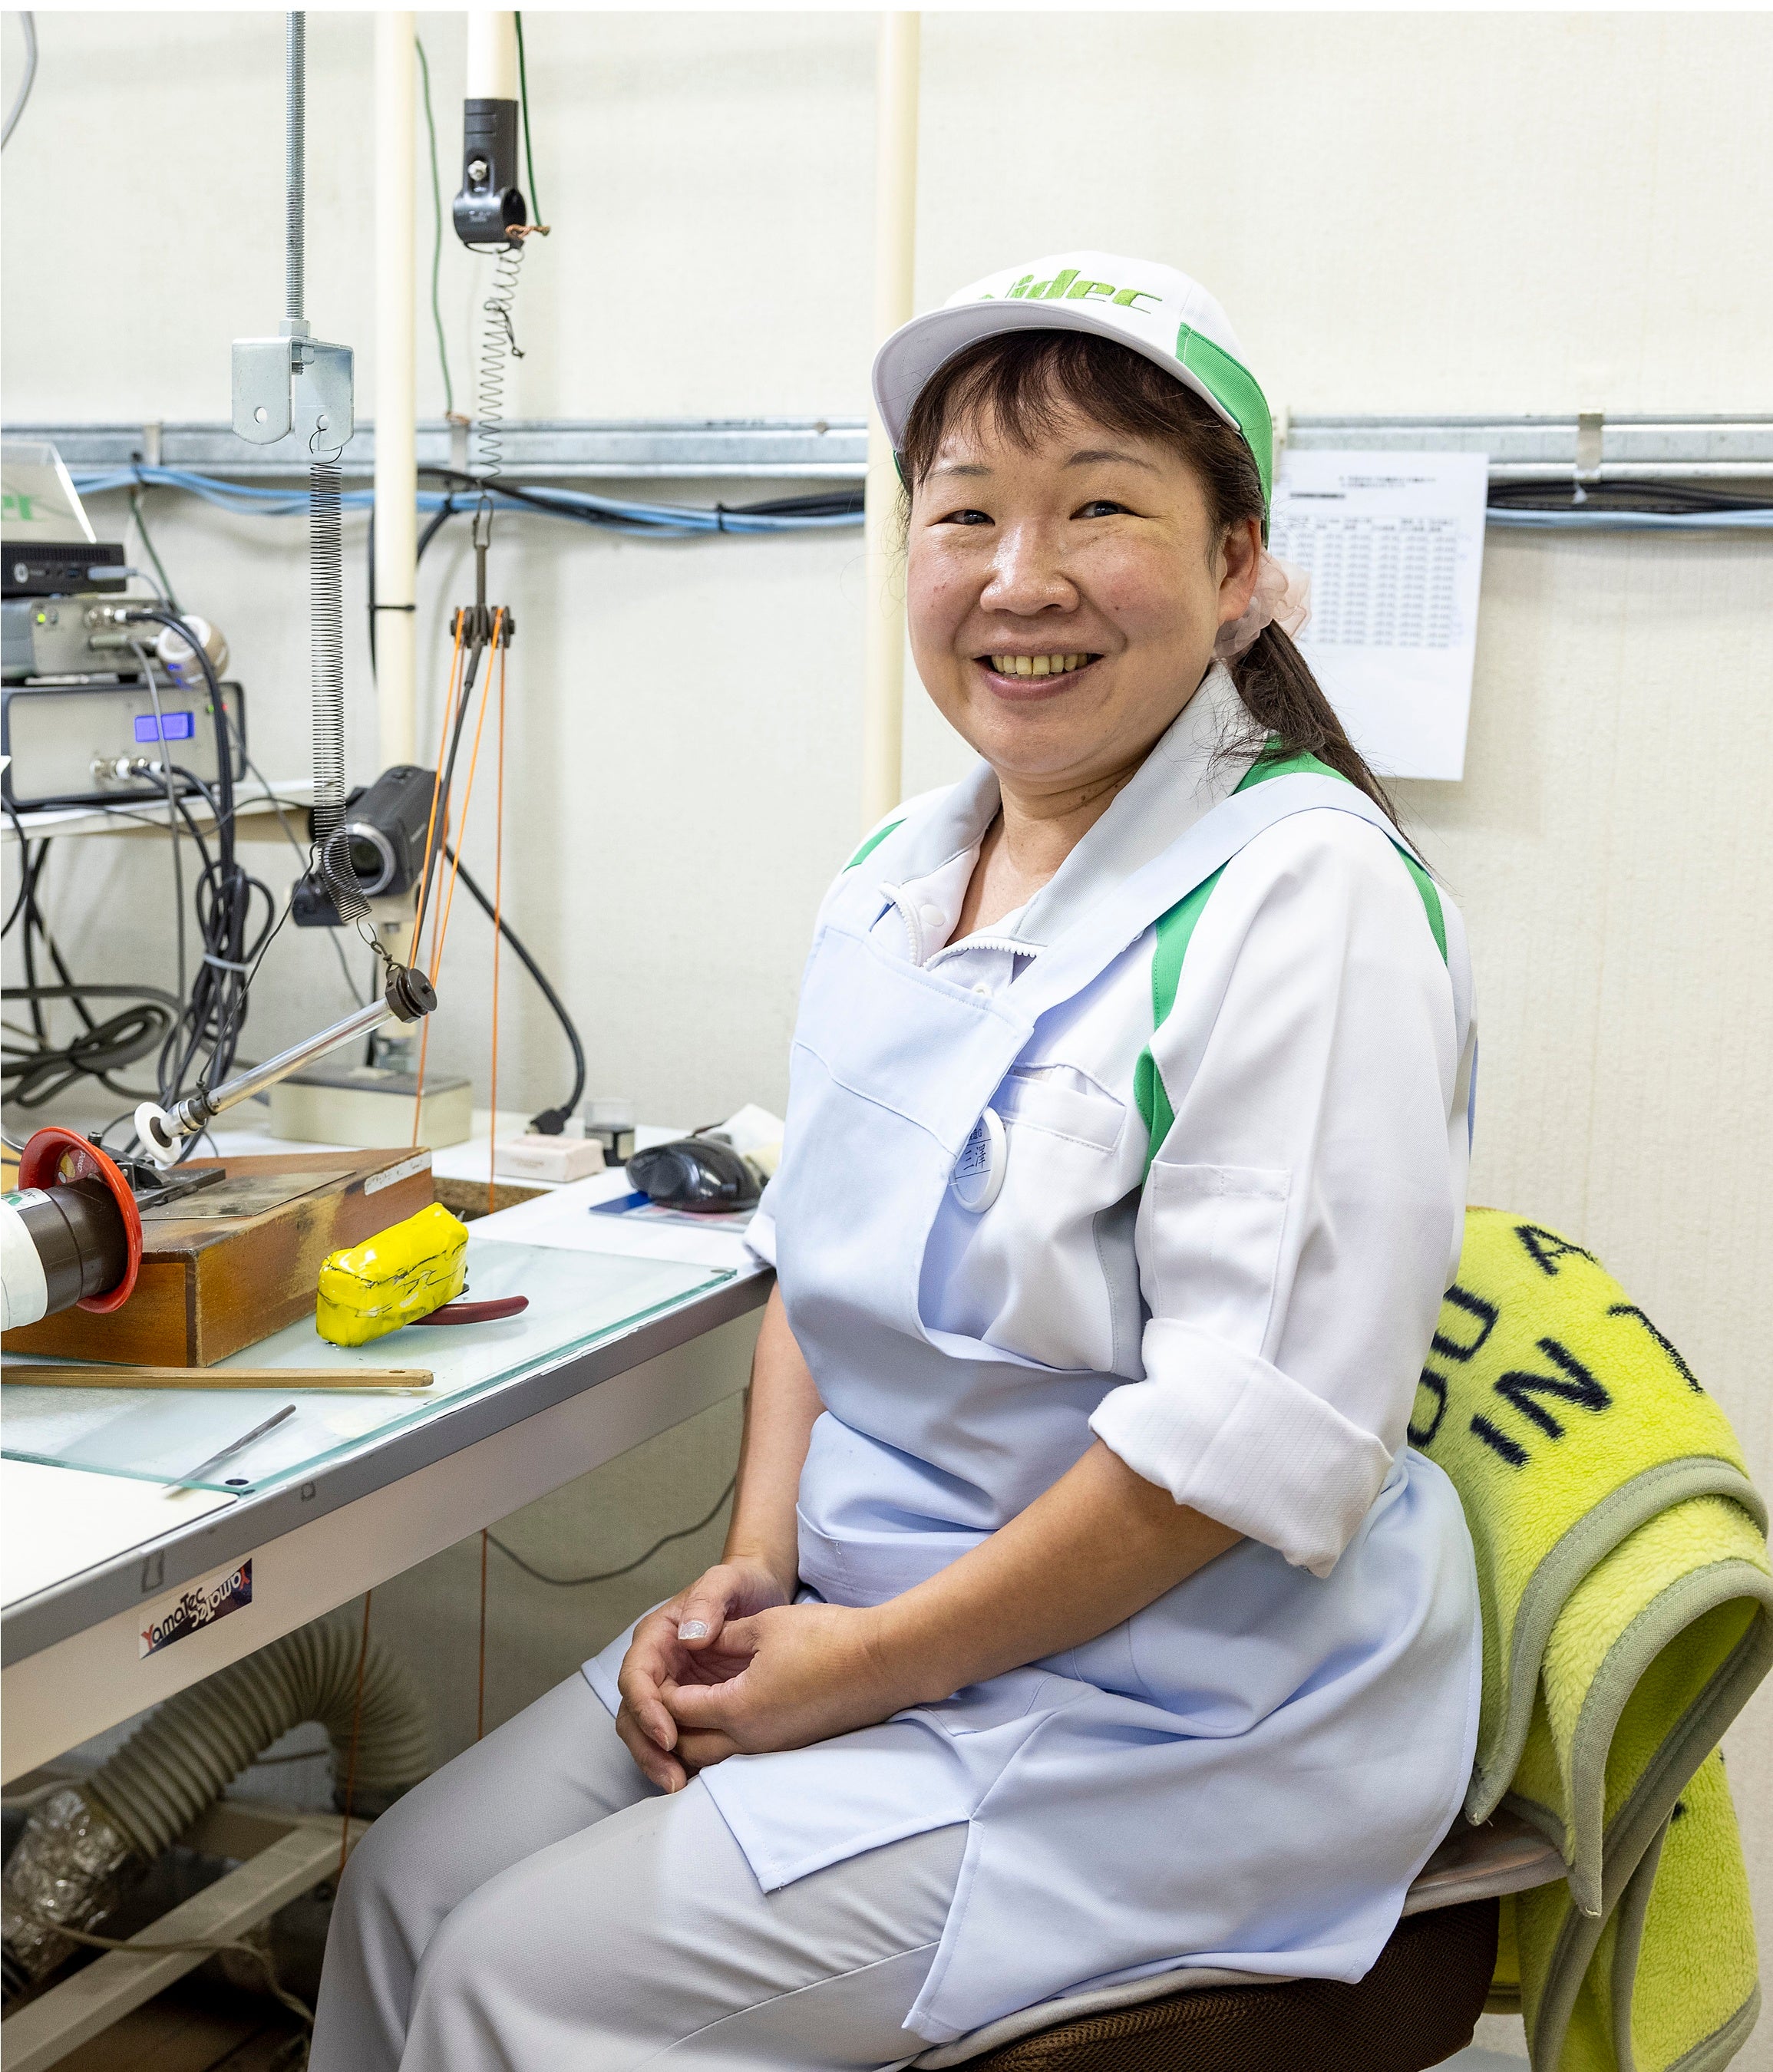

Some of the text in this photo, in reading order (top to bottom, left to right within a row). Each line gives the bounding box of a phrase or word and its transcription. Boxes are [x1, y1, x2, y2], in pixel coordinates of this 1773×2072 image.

[979, 269, 1163, 314] idec
[1469, 1337, 1614, 1468] IN
[141, 1586, 205, 1650] YamaTec
